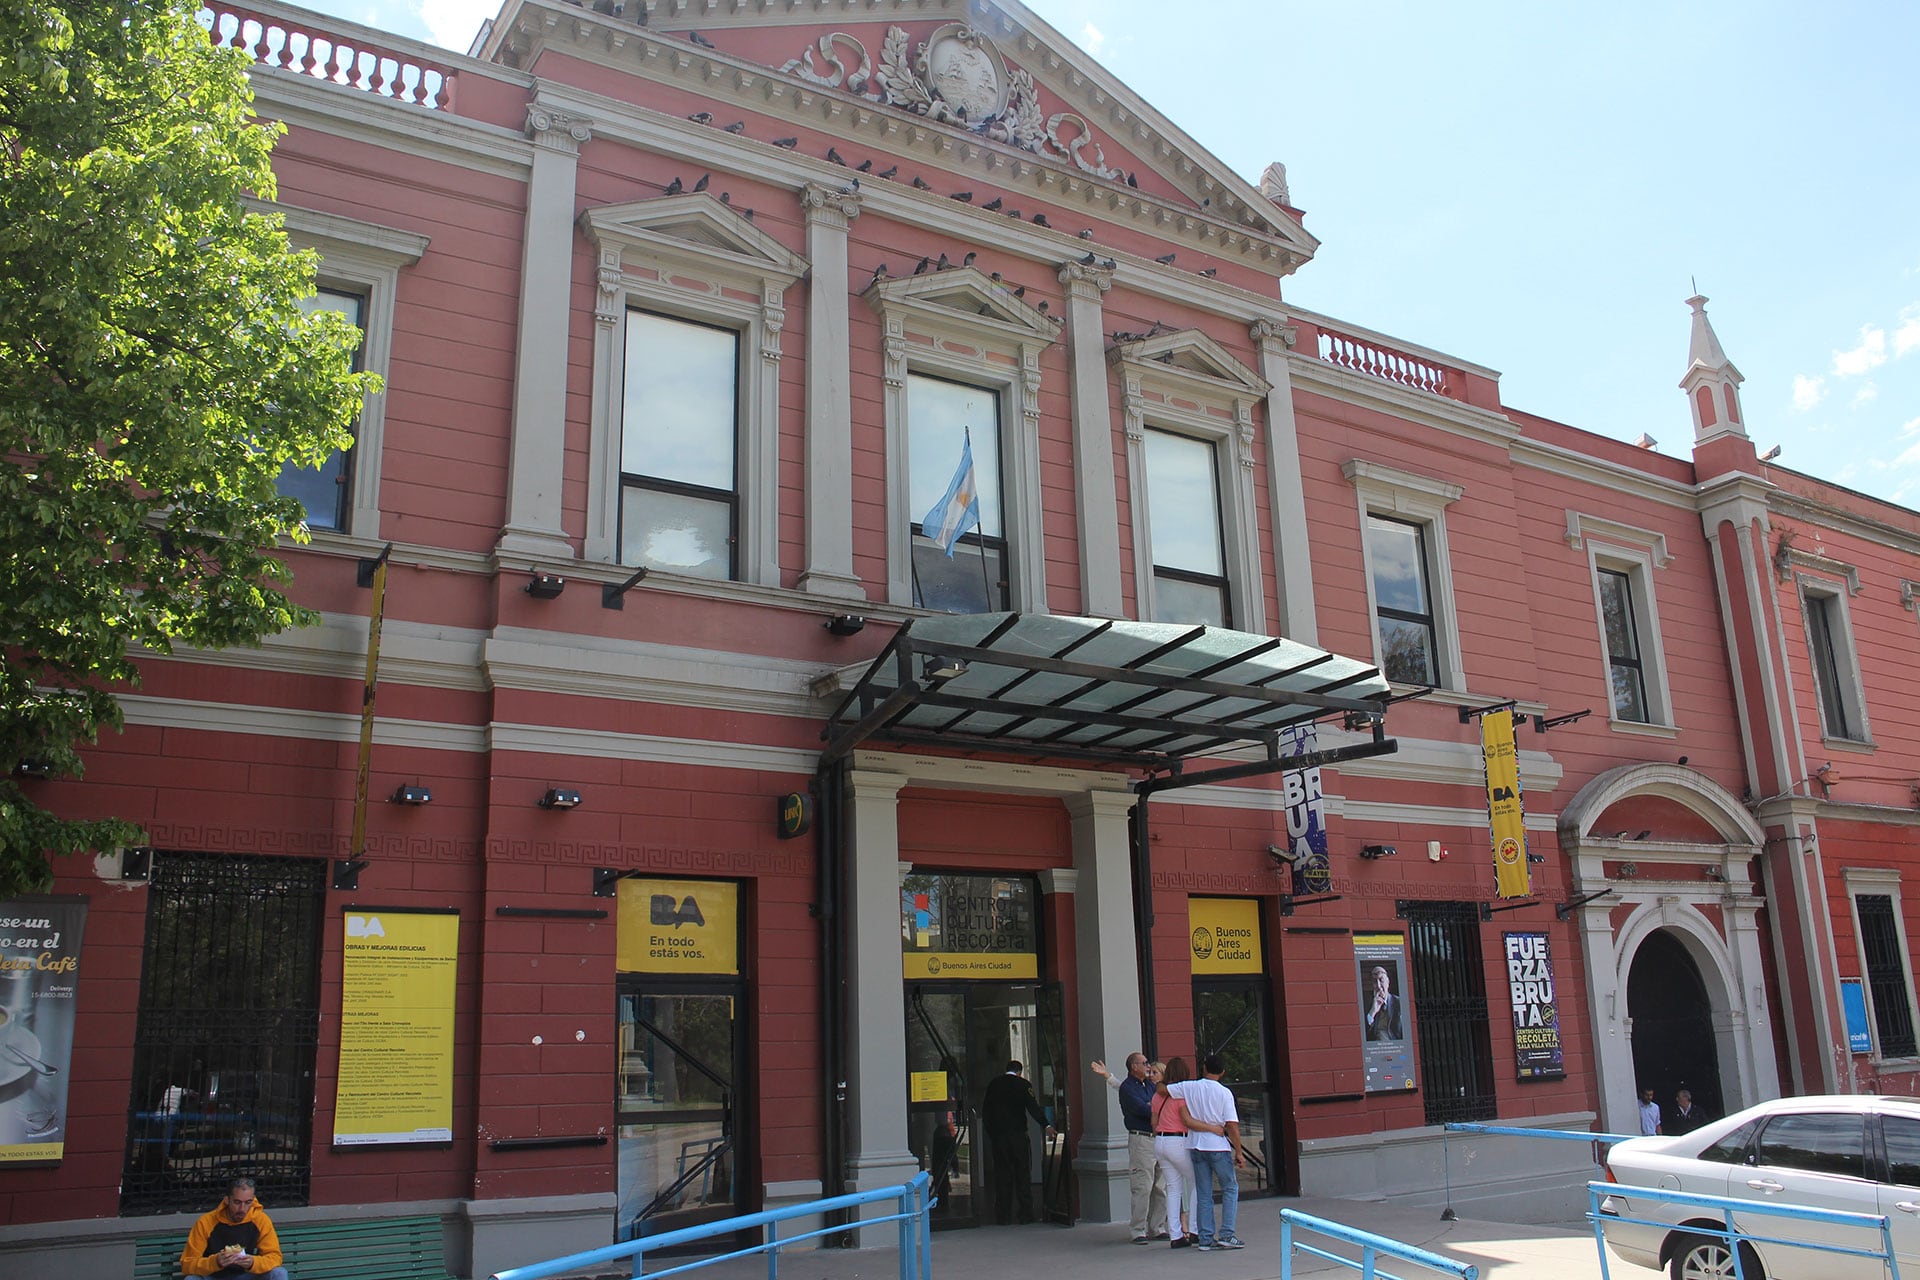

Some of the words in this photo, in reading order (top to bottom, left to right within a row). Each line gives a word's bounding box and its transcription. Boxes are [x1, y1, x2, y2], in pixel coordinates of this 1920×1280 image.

[1283, 766, 1322, 808] BR
[1493, 786, 1514, 801] BA
[650, 894, 705, 930] BA
[347, 916, 385, 939] BA
[1216, 926, 1251, 937] Buenos
[16, 937, 39, 948] en
[43, 932, 60, 948] el
[650, 936, 664, 946] En
[668, 937, 695, 946] todo
[1217, 938, 1240, 948] Aires
[1506, 937, 1546, 960] FUE
[36, 951, 77, 974] Café
[649, 948, 679, 958] estás
[682, 950, 705, 959] vos.
[1217, 949, 1251, 960] Ciudad
[1508, 960, 1551, 982] RZA
[1510, 981, 1553, 1004] BRU
[1513, 1004, 1543, 1027] TA
[1517, 1033, 1558, 1043] RECOLETA
